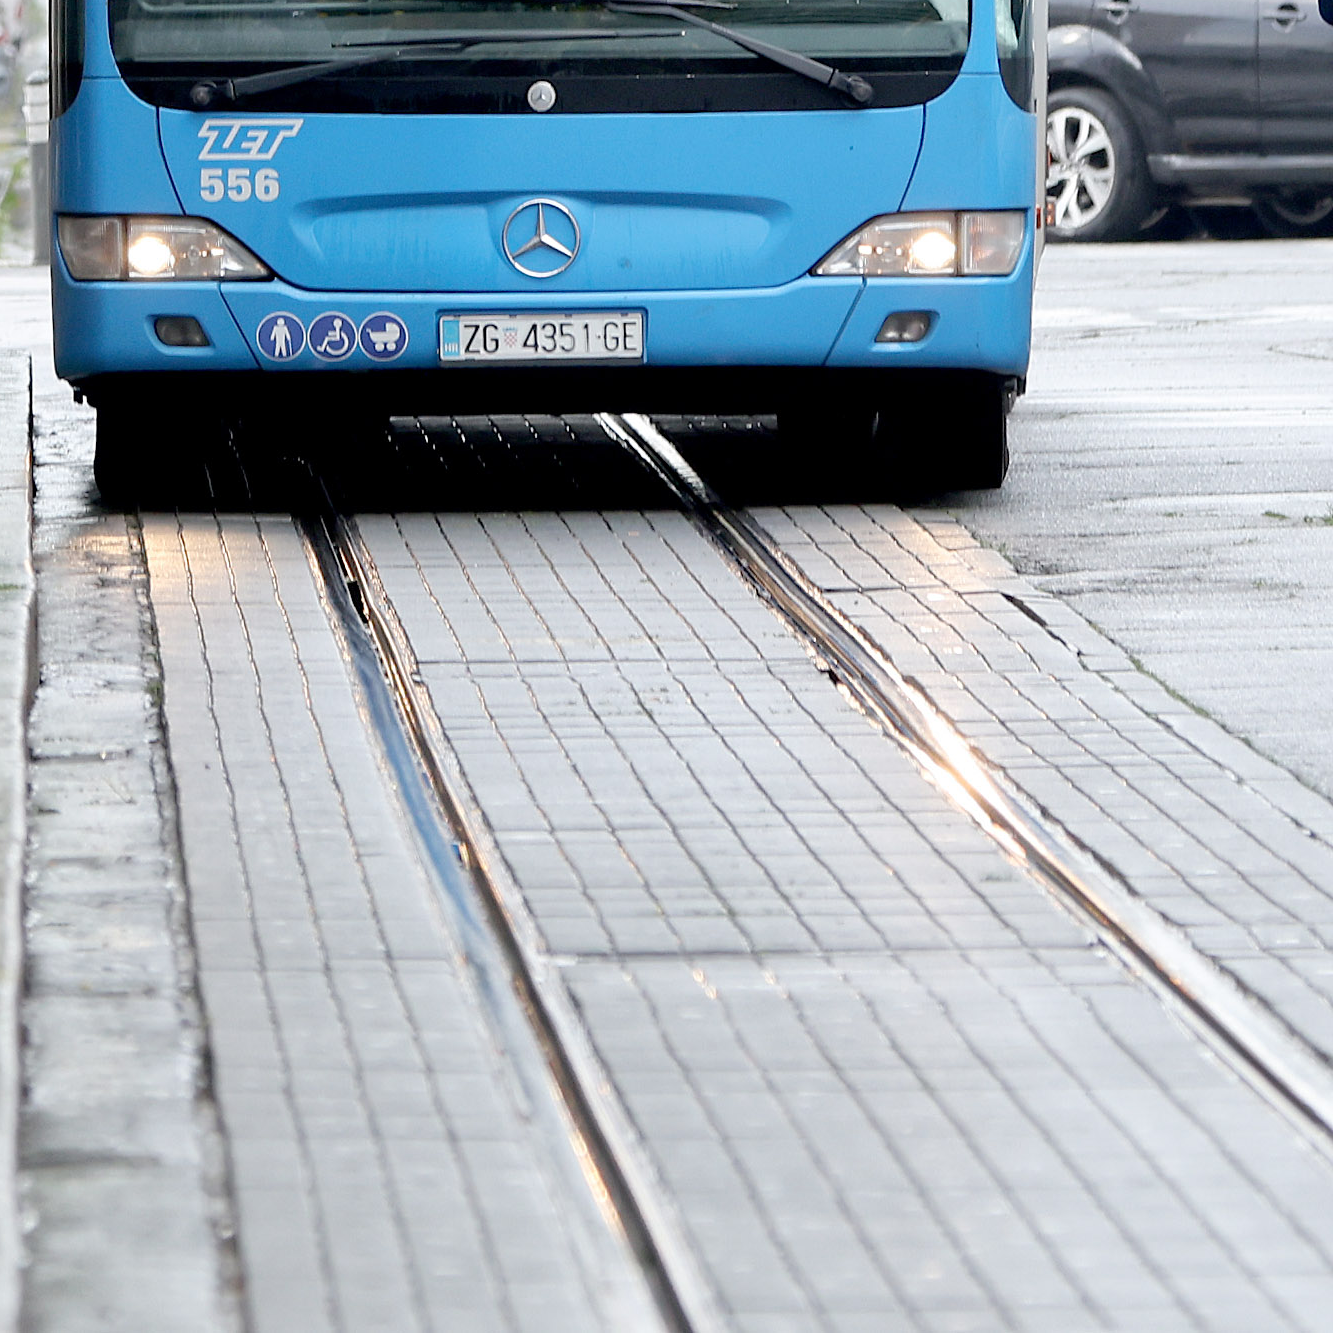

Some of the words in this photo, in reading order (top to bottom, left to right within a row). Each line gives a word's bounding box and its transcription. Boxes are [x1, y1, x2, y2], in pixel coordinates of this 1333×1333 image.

[198, 118, 304, 160] ZET
[199, 168, 280, 203] 556
[464, 324, 499, 354] ZG
